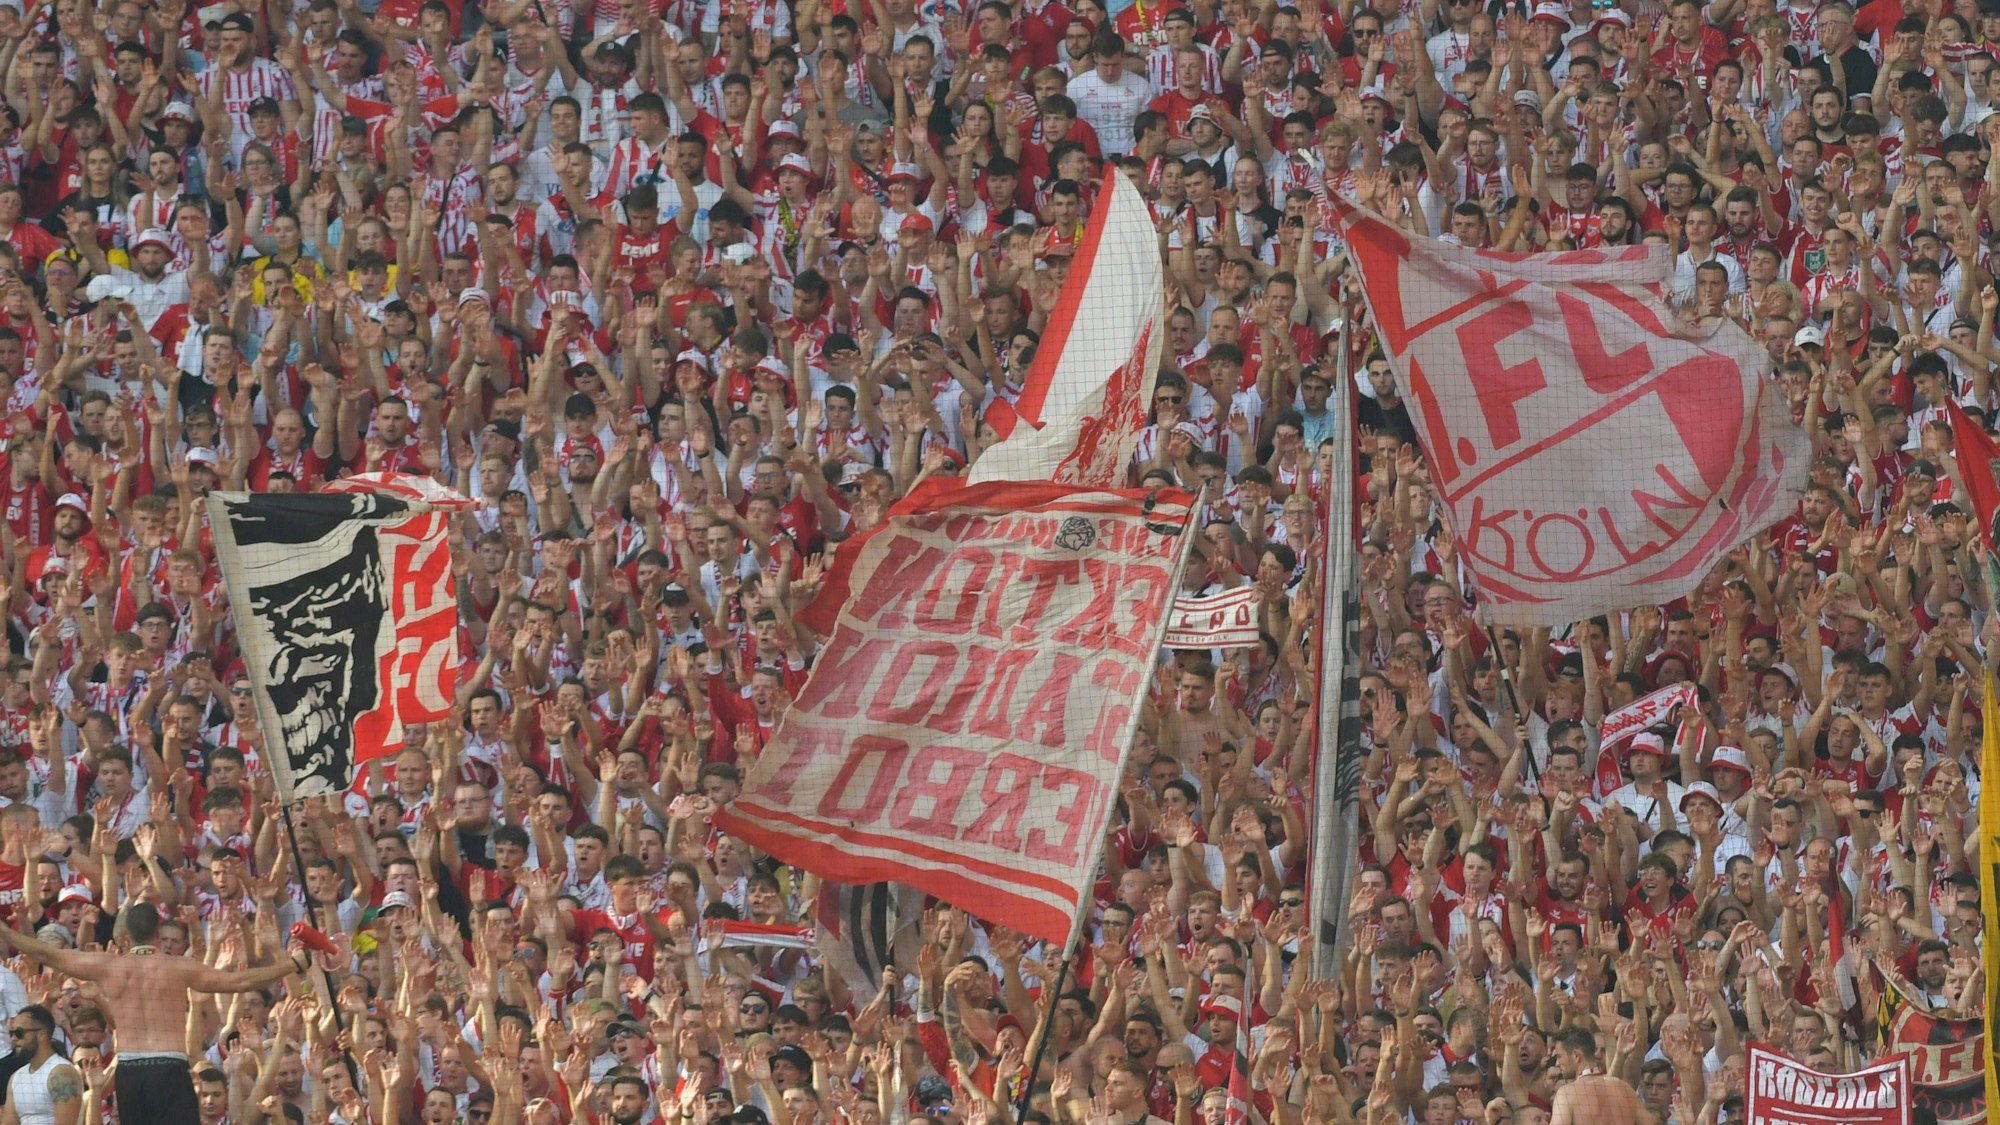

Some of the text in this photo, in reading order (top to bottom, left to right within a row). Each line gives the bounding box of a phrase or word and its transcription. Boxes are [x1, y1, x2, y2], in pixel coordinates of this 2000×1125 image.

[619, 241, 659, 257] REWE
[1468, 463, 1712, 578] KÖLN
[1757, 1059, 1897, 1109] RASCALS
